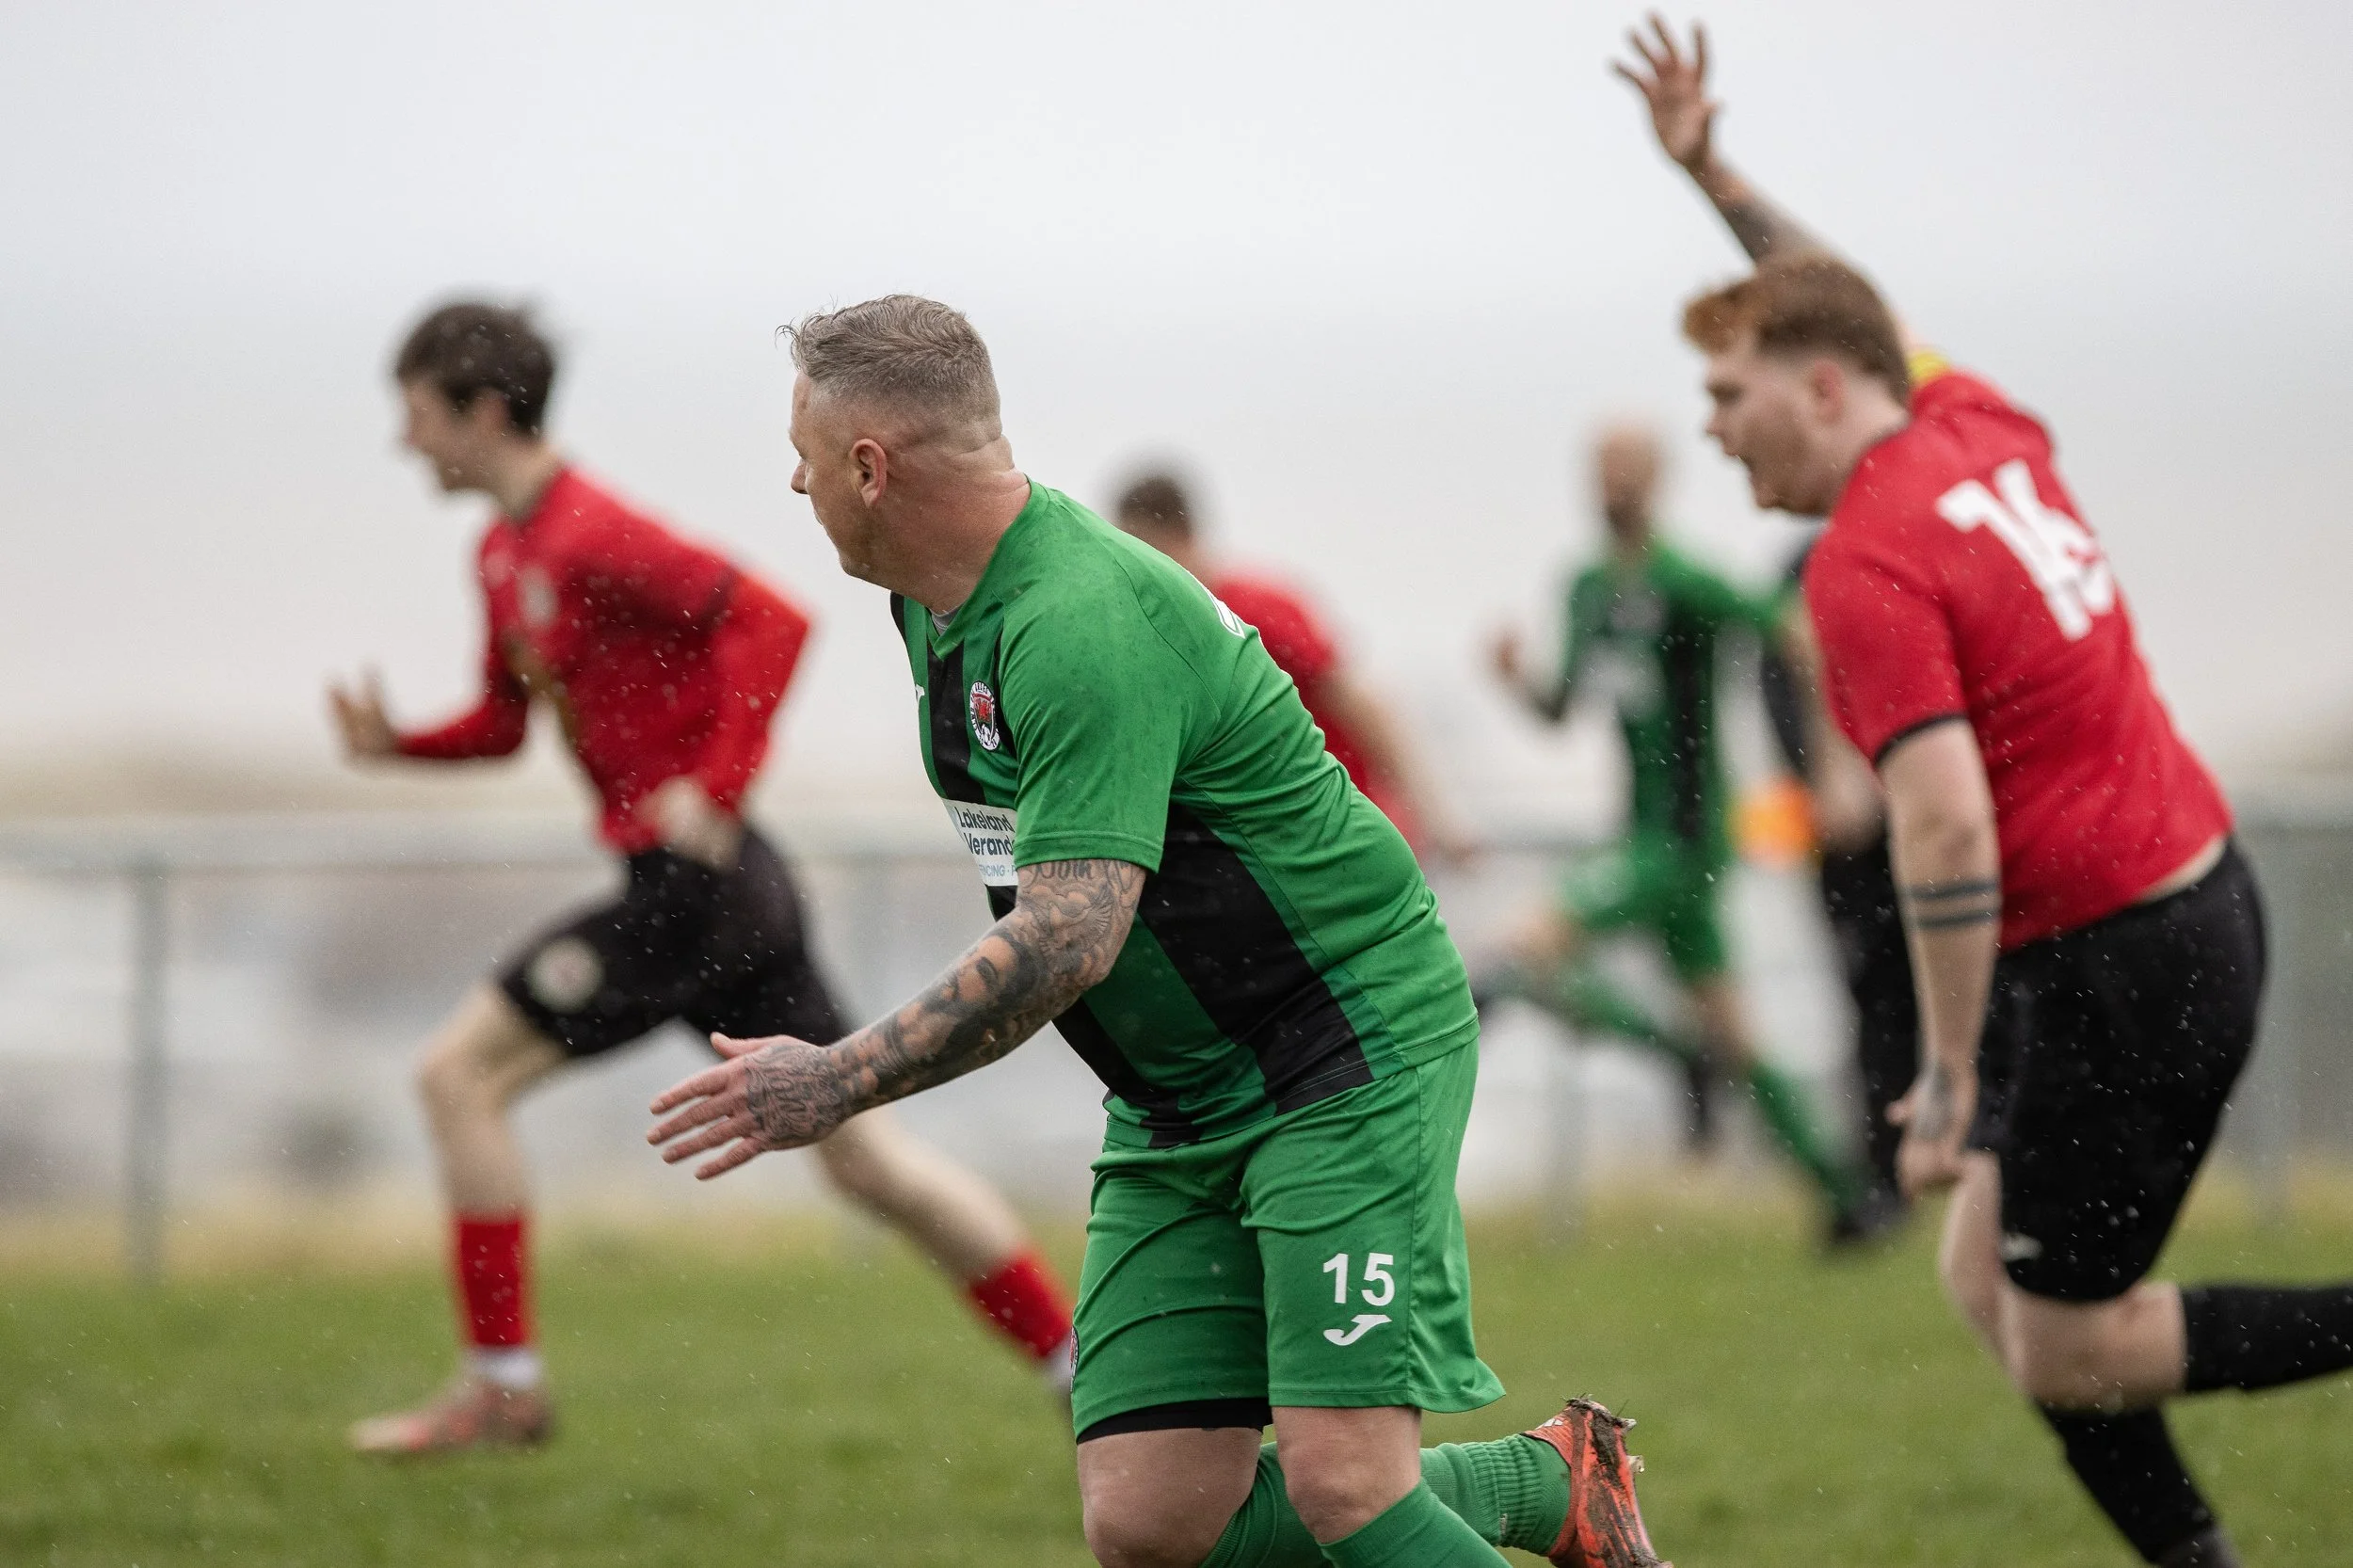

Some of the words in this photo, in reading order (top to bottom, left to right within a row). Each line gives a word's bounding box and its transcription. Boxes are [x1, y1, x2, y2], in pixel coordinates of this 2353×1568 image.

[1937, 458, 2116, 640] 16
[954, 806, 1016, 833] Lakeland
[963, 832, 1016, 856] Verand
[1322, 1252, 1396, 1306] 15
